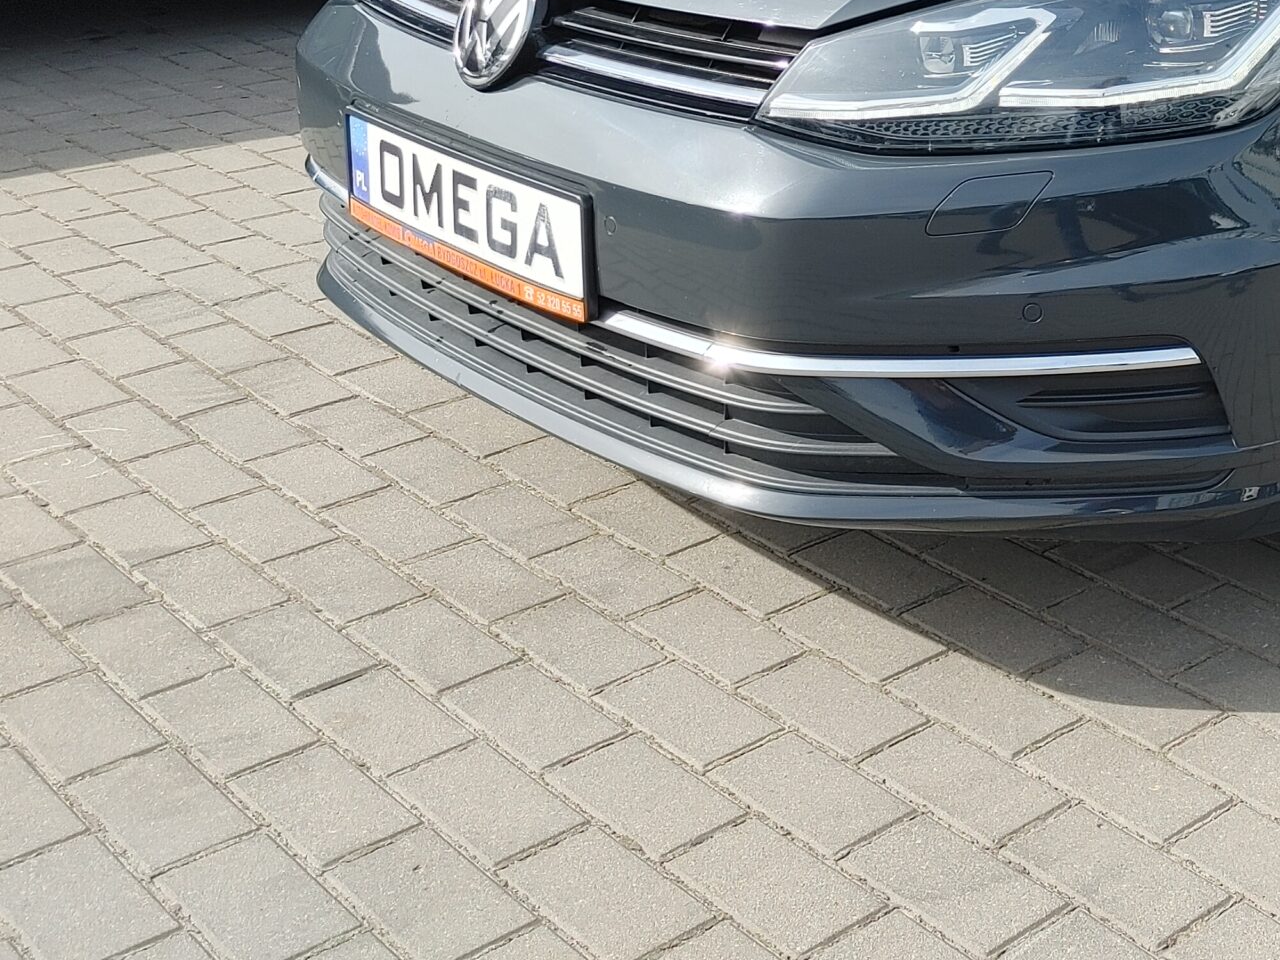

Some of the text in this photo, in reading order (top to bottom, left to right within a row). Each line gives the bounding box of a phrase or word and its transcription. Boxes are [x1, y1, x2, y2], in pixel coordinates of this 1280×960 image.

[355, 169, 367, 191] PL
[379, 139, 565, 280] OMEGA
[536, 292, 546, 305] 52
[547, 297, 560, 312] 320
[562, 302, 572, 315] 55
[573, 305, 583, 318] 55
